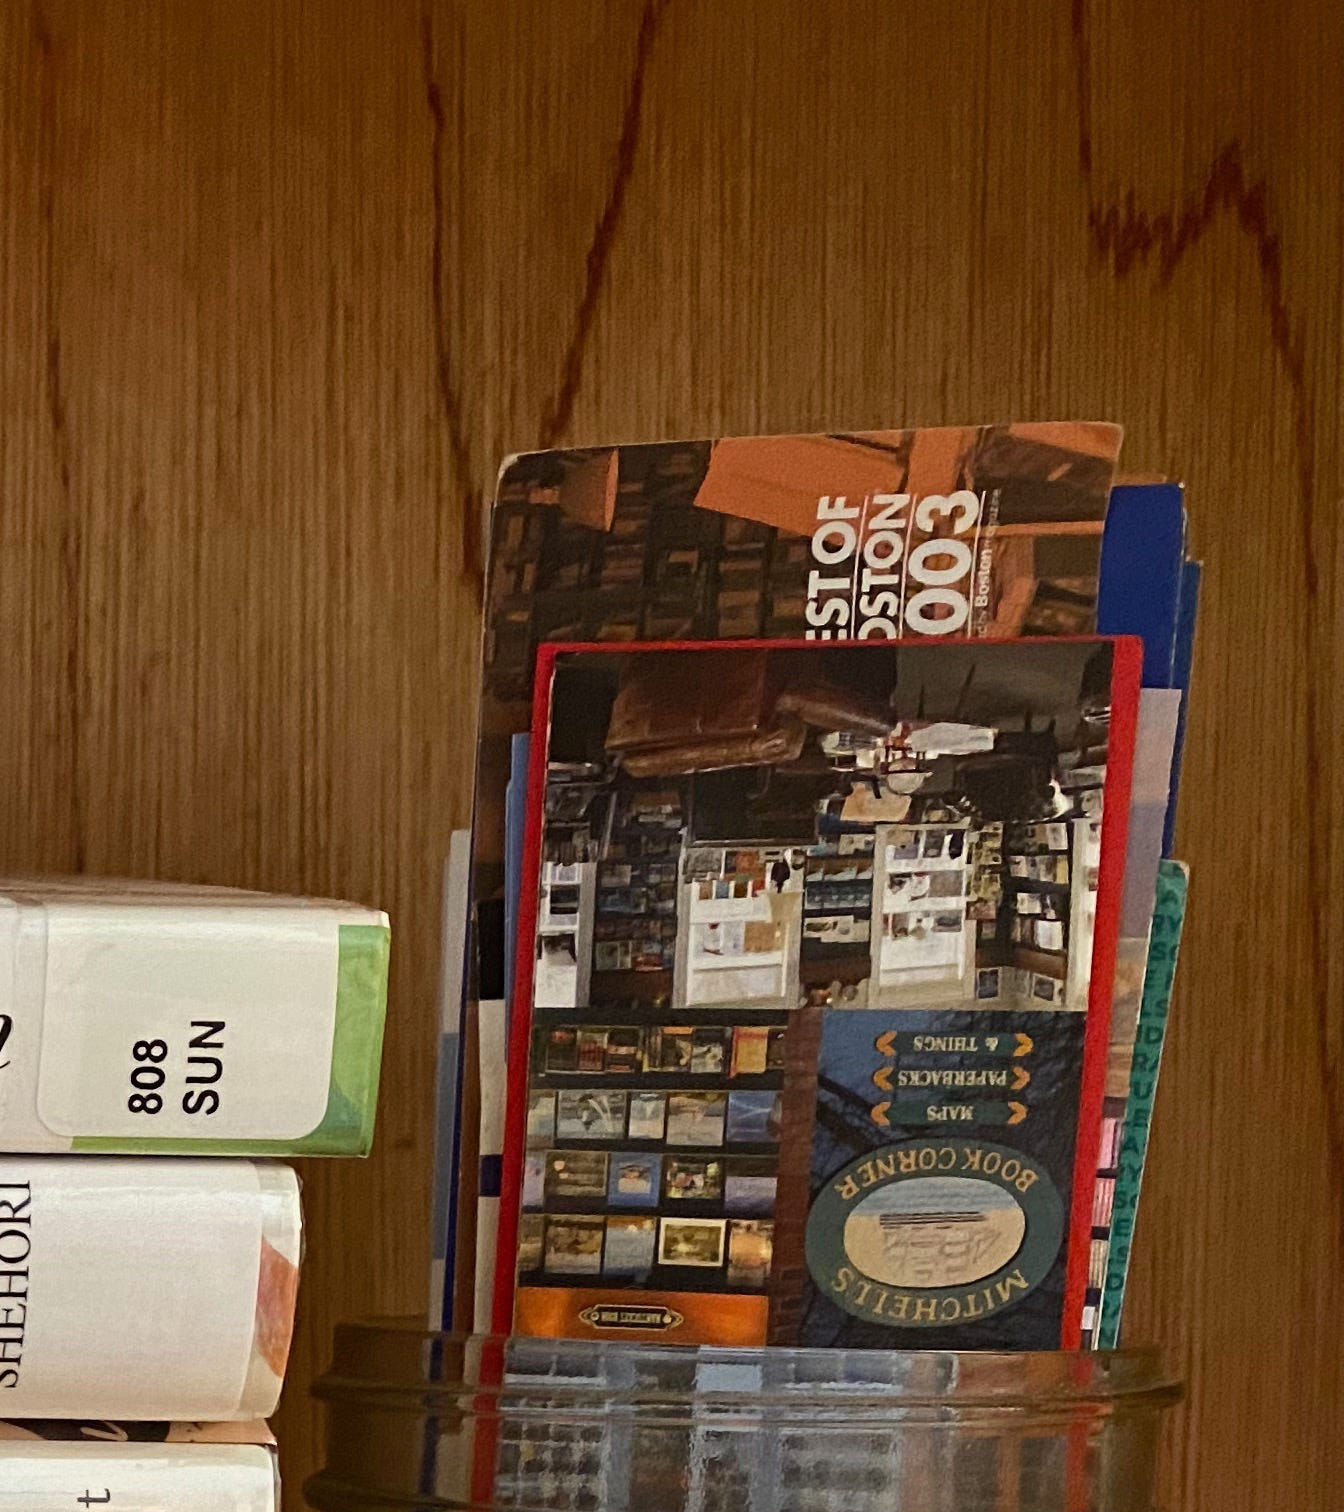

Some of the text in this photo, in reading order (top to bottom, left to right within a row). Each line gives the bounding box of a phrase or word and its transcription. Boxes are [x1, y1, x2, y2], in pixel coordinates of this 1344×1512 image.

[811, 495, 861, 564] OF
[856, 494, 912, 640] OSTON
[905, 490, 981, 635] 003
[974, 549, 993, 608] Boston
[184, 1020, 226, 1115] SUN
[914, 1035, 976, 1053] THINGS
[128, 1038, 169, 1115] 808
[898, 1069, 1008, 1087] PAPERBACKS
[927, 1105, 974, 1121] MAPS
[833, 1147, 1040, 1202] BOOK CORNER
